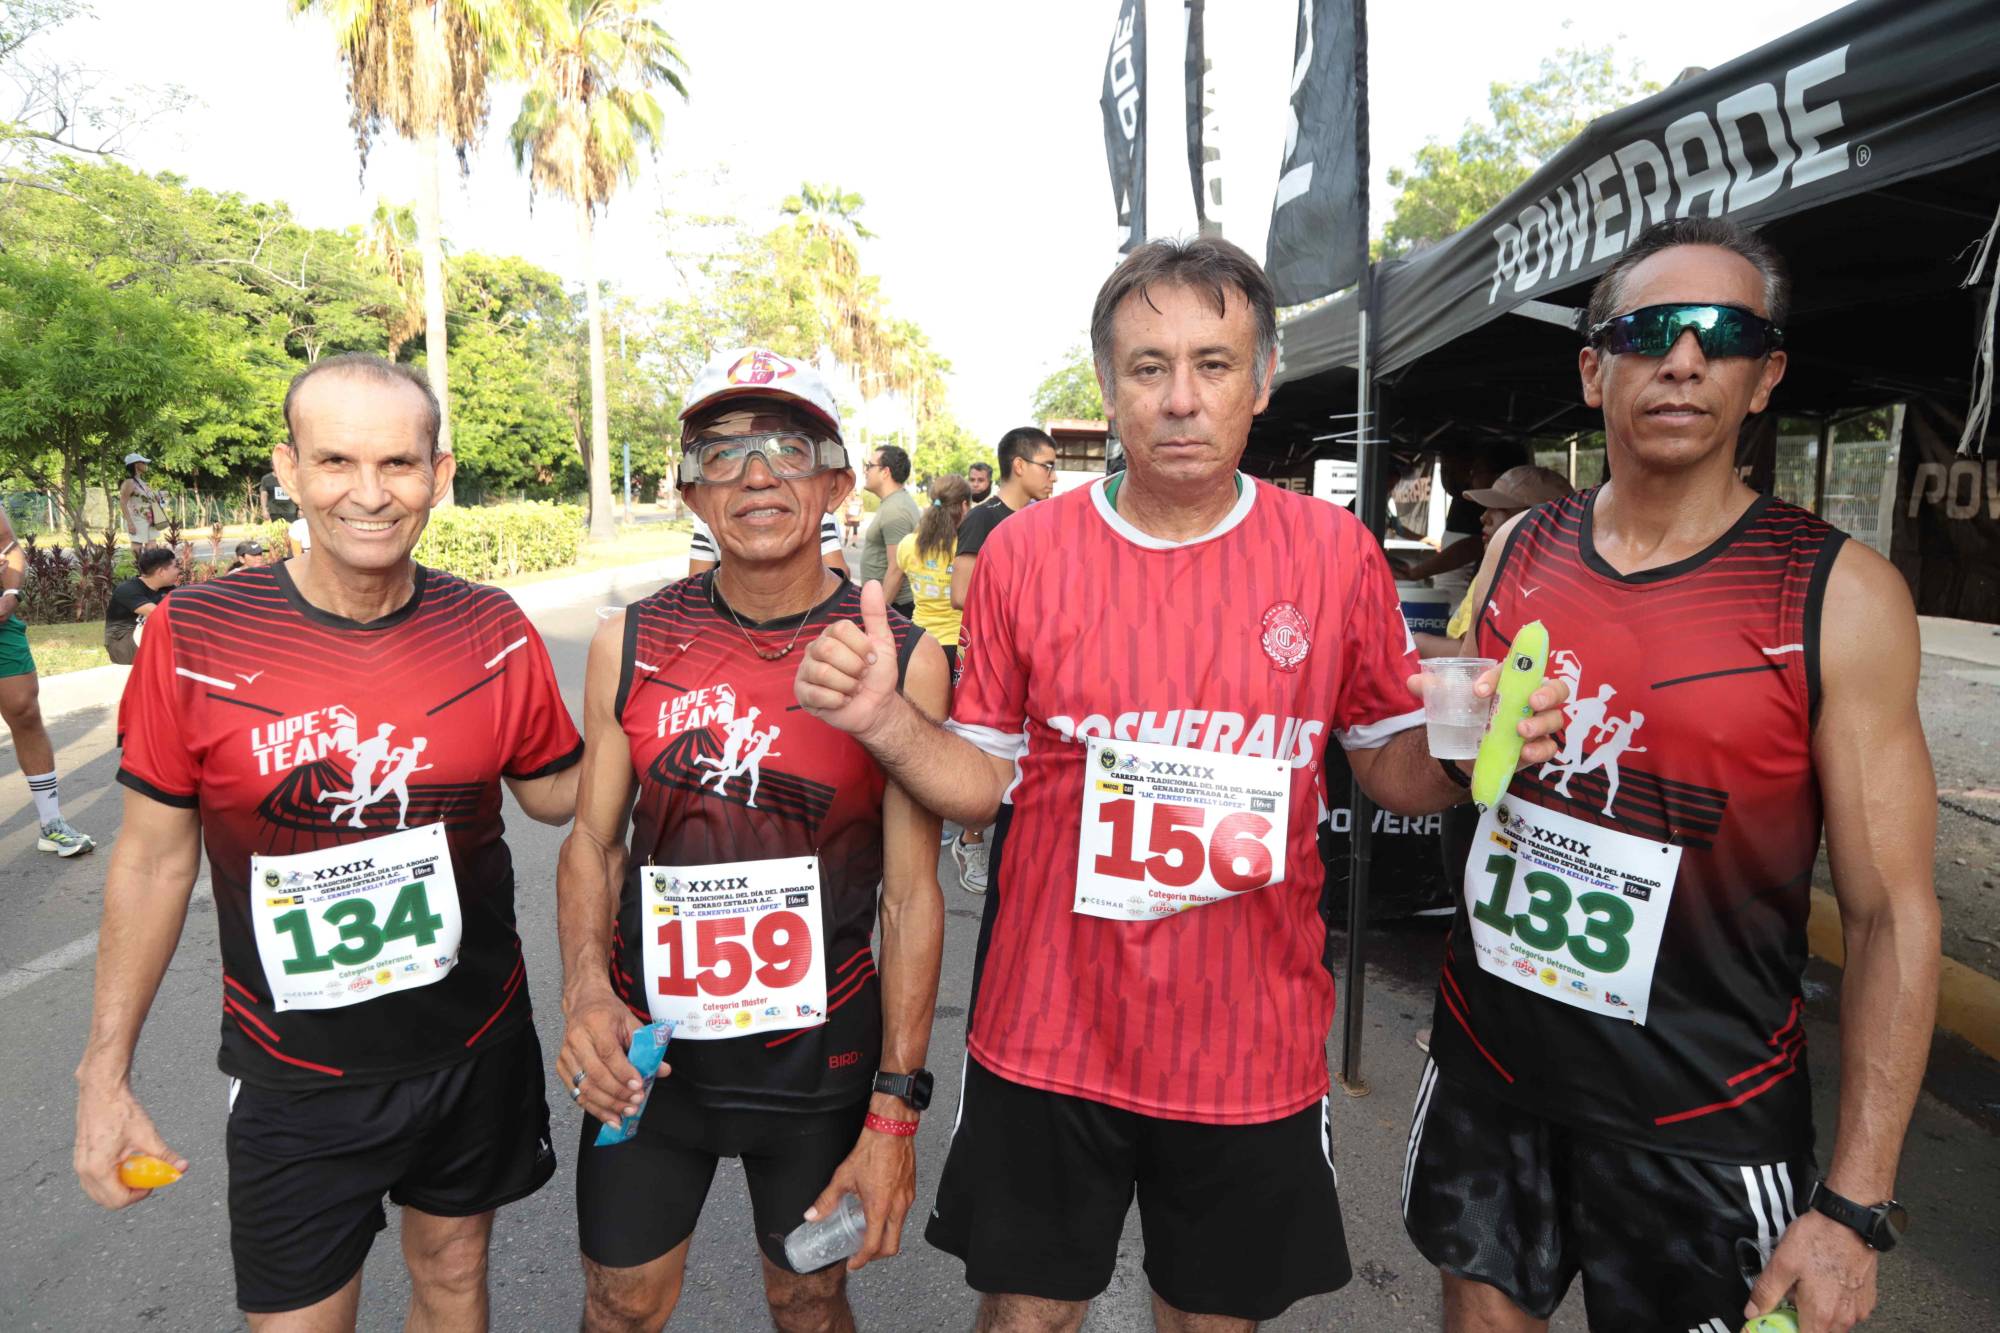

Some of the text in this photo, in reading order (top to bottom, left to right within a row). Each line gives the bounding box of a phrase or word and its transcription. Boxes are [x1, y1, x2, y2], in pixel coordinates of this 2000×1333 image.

[1489, 44, 1850, 304] POWERADE
[251, 704, 356, 751] LUPE'S
[657, 705, 734, 738] TEAM
[253, 732, 353, 776] TEAM
[1151, 761, 1215, 780] XXXIX
[1110, 772, 1144, 782] CARRERA
[1146, 776, 1197, 788] TRADICIONAL
[1200, 782, 1213, 790] DEL
[1230, 786, 1244, 794] DEL
[1246, 787, 1283, 798] ABOGADO
[1152, 784, 1184, 794] GENARO
[1186, 788, 1222, 798] ESTRADA
[1157, 793, 1192, 803] ERNESTO
[1327, 808, 1442, 835] OERA
[1094, 798, 1273, 892] 156
[1532, 826, 1592, 857] XXXIX
[313, 858, 375, 881] XXXIX
[313, 874, 362, 889] TRADICIONAL
[364, 870, 376, 879] DEL
[406, 855, 439, 868] ABOGADO
[1527, 838, 1573, 861] TRADICIONAL
[1574, 856, 1587, 867] DEL
[1588, 861, 1602, 872] DÍA
[1604, 867, 1619, 877] DEL
[1620, 872, 1661, 888] ABOGADO
[1531, 848, 1611, 882] GENARO ESTRADA A.C.
[1533, 857, 1566, 874] ERNESTO
[1566, 870, 1590, 882] KELLY
[321, 884, 351, 895] GENARO
[687, 893, 733, 902] TRADICIONAL
[736, 891, 748, 899] DEL
[780, 885, 814, 894] ABOGADO
[688, 877, 748, 893] XXXIX
[698, 909, 731, 917] ERNESTO
[732, 906, 753, 914] KELLY
[723, 898, 758, 907] ESTRADA
[1473, 854, 1634, 973] 133
[273, 881, 443, 975] 134
[658, 911, 812, 997] 159
[1546, 957, 1585, 978] Veteranos
